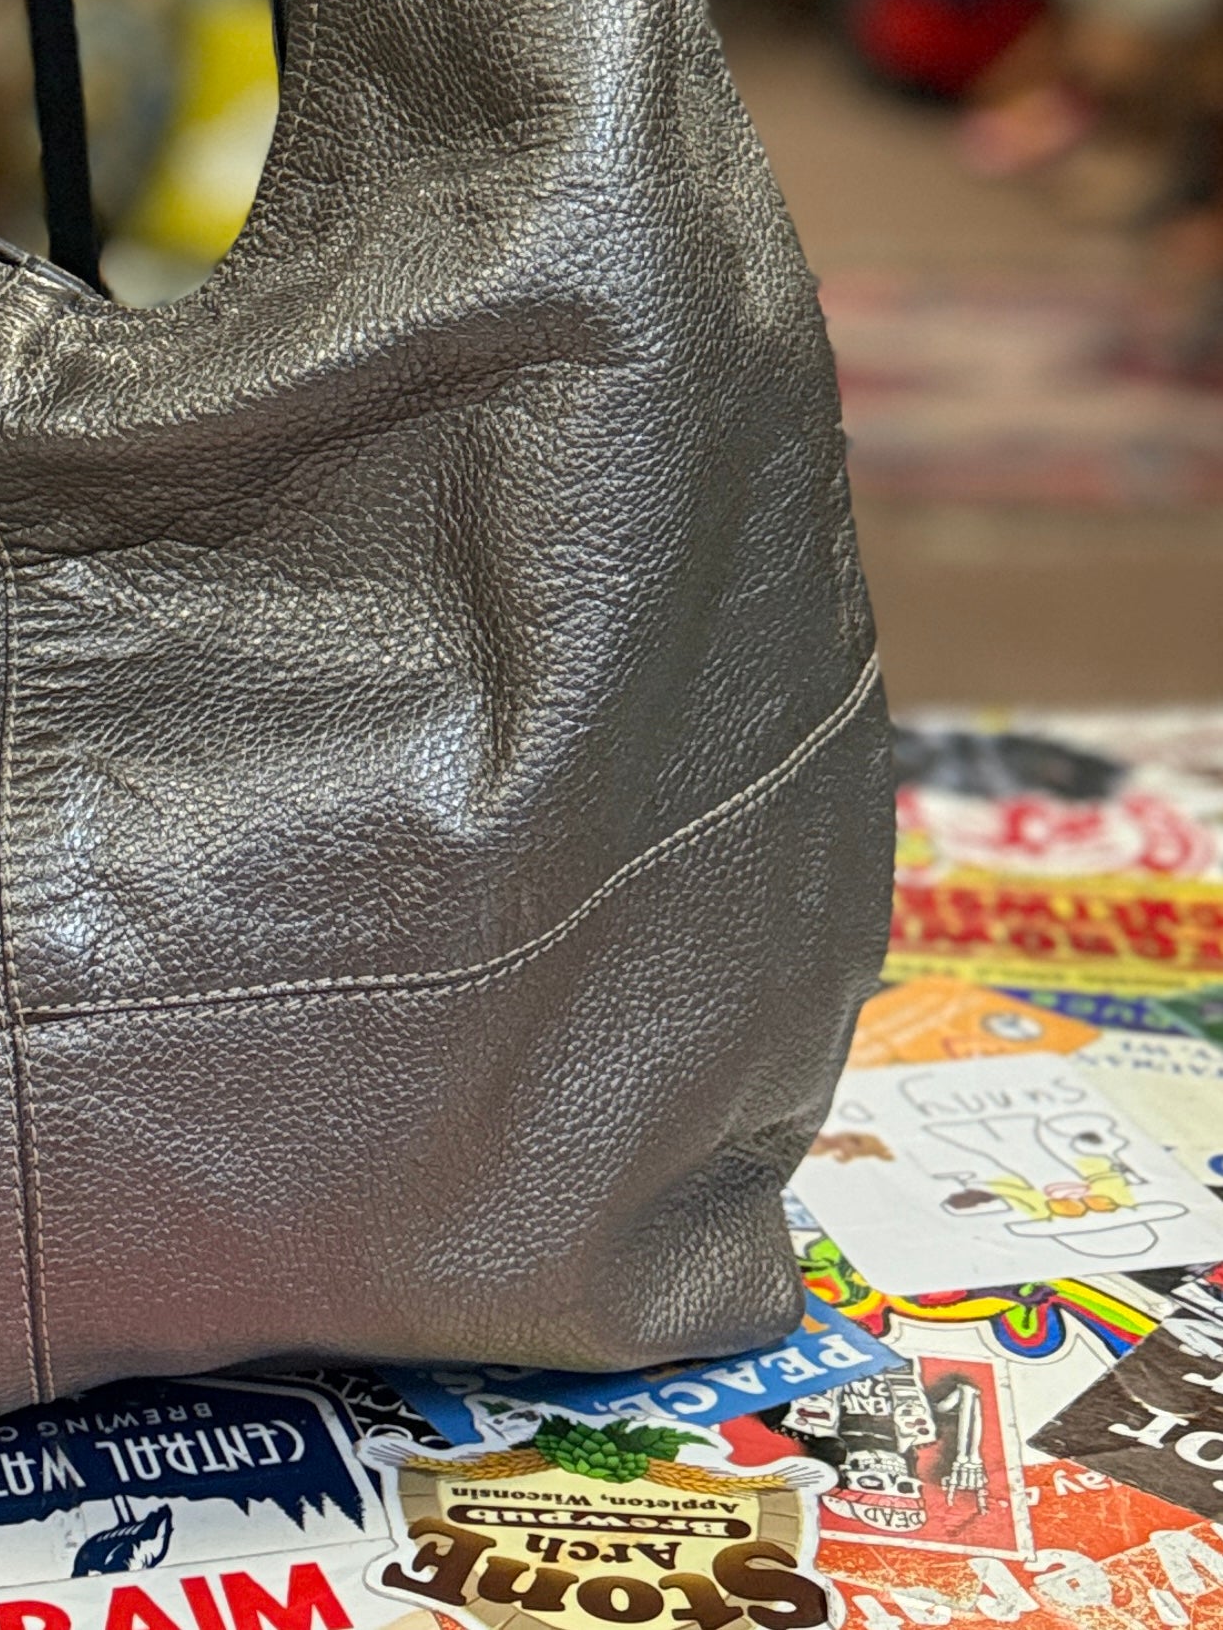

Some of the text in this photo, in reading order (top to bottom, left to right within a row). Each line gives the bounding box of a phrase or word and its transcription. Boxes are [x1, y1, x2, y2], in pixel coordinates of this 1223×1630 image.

[38, 1401, 214, 1436] BREWING
[97, 1419, 307, 1483] CENTRAL
[452, 1486, 740, 1514] Appleton, Wisconsin
[468, 1507, 731, 1538] Brewpub
[863, 1507, 924, 1530] DEAD
[525, 1532, 682, 1570] Arch
